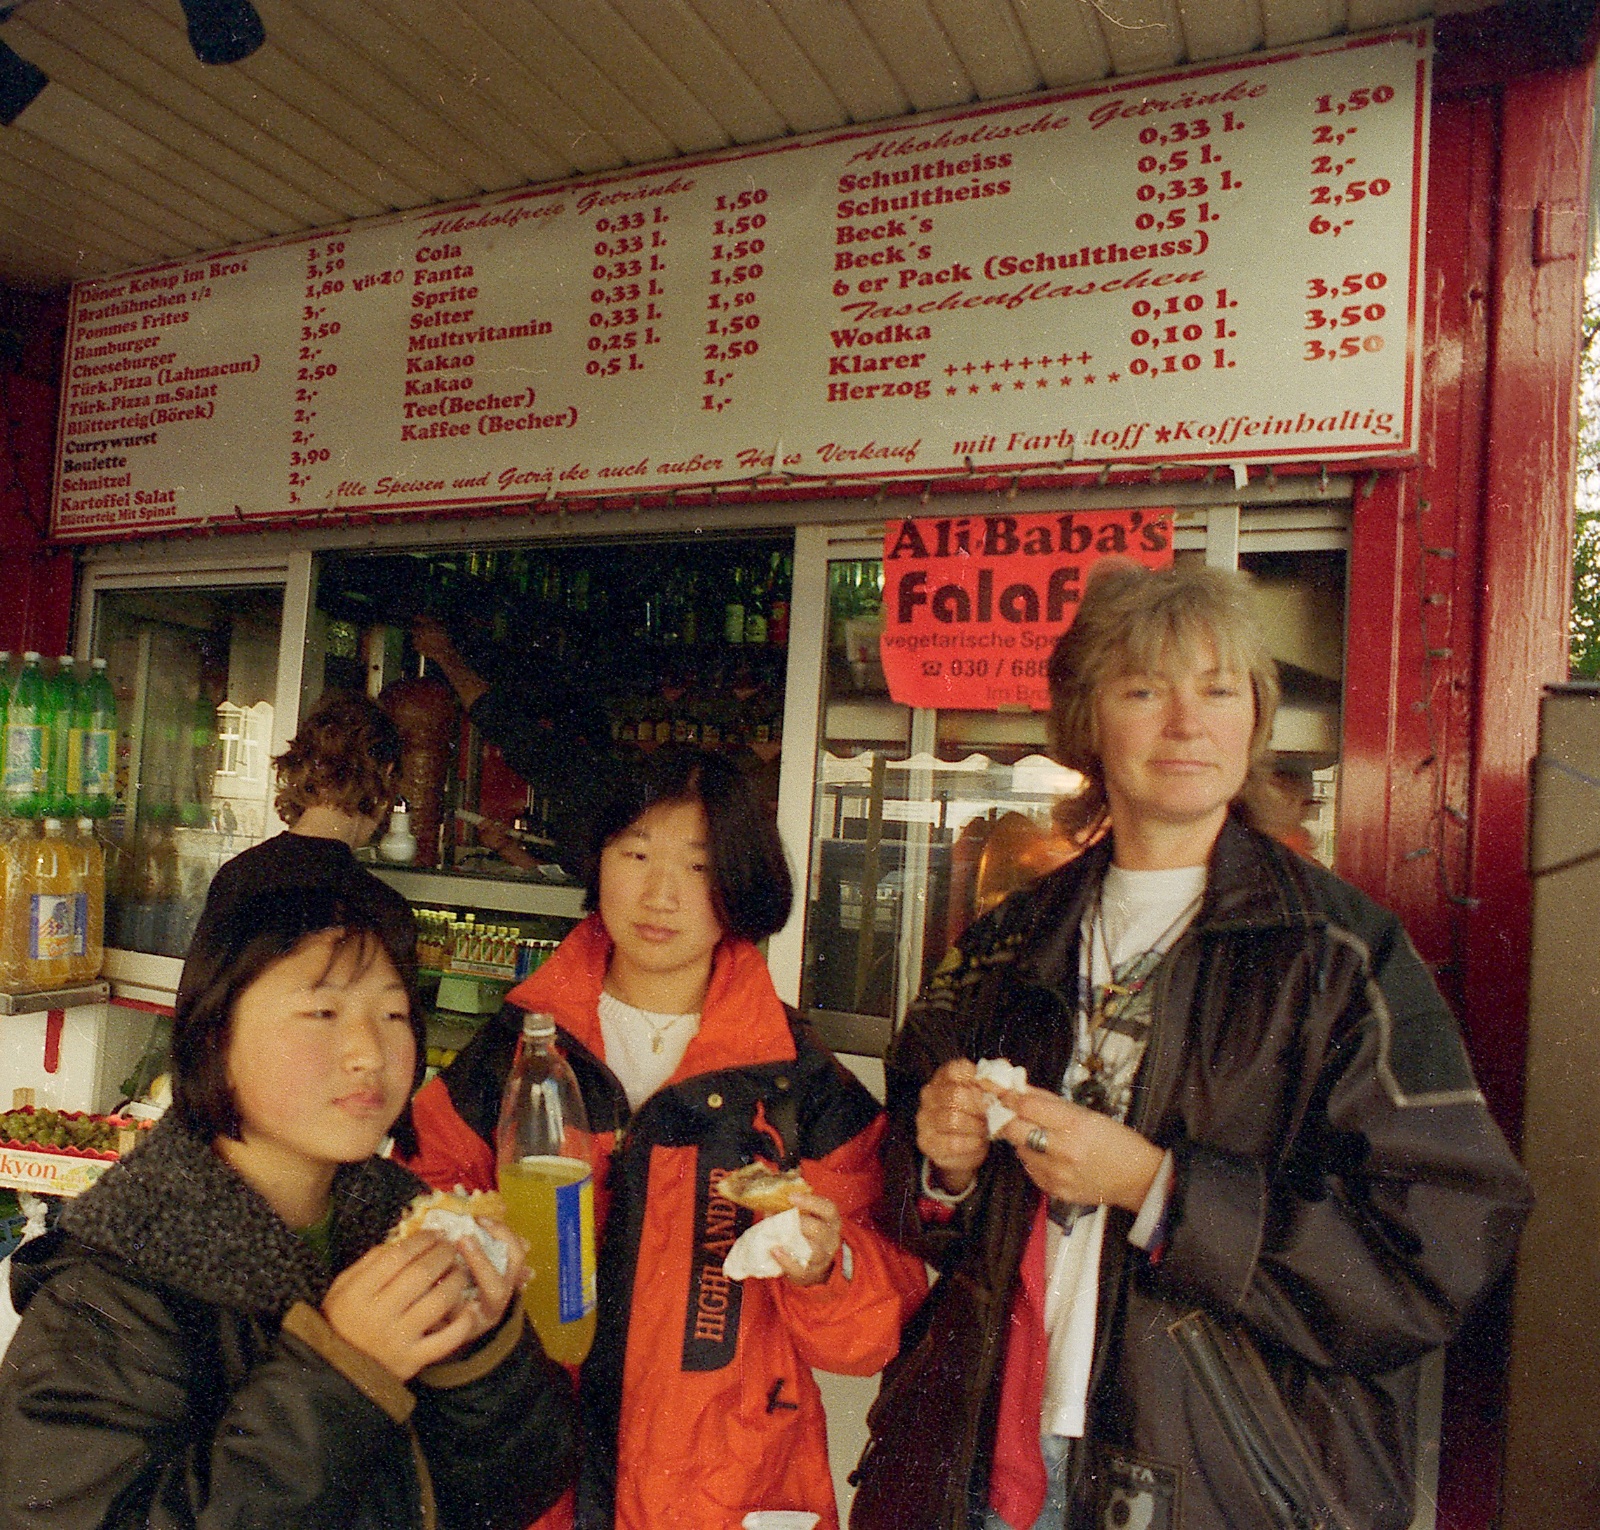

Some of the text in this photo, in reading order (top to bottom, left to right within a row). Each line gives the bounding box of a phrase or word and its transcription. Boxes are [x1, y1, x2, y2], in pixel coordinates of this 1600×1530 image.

[838, 152, 1012, 194] Schultheiss
[1138, 118, 1211, 146] 0,33
[1314, 84, 1395, 116] 1,50
[845, 79, 1269, 166] Alkoholische Getränke
[576, 177, 697, 215] Getränke
[837, 178, 1012, 220] Schultheiss
[1137, 150, 1188, 175] 0,5
[1312, 124, 1358, 145] 2,-
[1136, 176, 1208, 204] 0,33
[1310, 155, 1356, 176] 2,-
[415, 244, 462, 262] Cola
[596, 212, 645, 233] 0,33
[714, 189, 768, 212] 1,50
[1135, 208, 1186, 232] 0,5
[1310, 178, 1392, 206] 2,50
[411, 284, 478, 308] Sprite
[593, 259, 642, 281] 0,33
[711, 238, 765, 262] 1,50
[414, 264, 474, 285] Fanta
[594, 236, 643, 257] 0,33
[712, 214, 766, 237] 1,50
[898, 263, 973, 289] Pack
[984, 230, 1210, 280] (Schultheiss)
[1308, 214, 1354, 237] 6,-
[78, 292, 186, 323] Brathähnchen
[307, 259, 345, 279] 3,50
[80, 285, 125, 304] Döner
[129, 274, 178, 294] Kebap
[183, 269, 204, 284] im
[410, 308, 474, 330] Selter
[591, 283, 640, 305] 0,33
[709, 264, 763, 287] 1,50
[830, 323, 932, 348] Wodka
[1131, 294, 1204, 320] 0,10
[1306, 271, 1388, 300] 3,50
[841, 269, 1205, 321] Taschenflaschen
[74, 336, 160, 360] Hamburger
[76, 320, 137, 342] Pommes
[142, 312, 190, 329] Frites
[406, 354, 475, 375] Kakao
[587, 331, 637, 353] 0,25
[706, 314, 760, 336] 1,50
[408, 319, 553, 353] Multivitamin
[589, 308, 638, 329] 0,33
[707, 292, 755, 312] 1,50
[828, 353, 926, 376] Klarer
[1130, 324, 1203, 348] 0,10
[1304, 303, 1386, 330] 3,50
[71, 376, 151, 398] Türk.Pizza
[158, 354, 261, 386] (Lahmacun)
[72, 322, 340, 379] Cheeseburger 3,50
[405, 377, 473, 396] Kakao
[586, 358, 621, 378] 0,5
[704, 340, 759, 362] 2,50
[827, 380, 932, 402] Herzog
[1130, 354, 1202, 378] 0,10
[1303, 334, 1385, 362] 3,50
[69, 364, 337, 416] Türk.Pizza m.Salat 2,50
[66, 432, 157, 454] Currywurst
[401, 420, 471, 441] Kaffee
[478, 406, 578, 436] (Becher)
[953, 435, 996, 455] mit
[62, 448, 330, 493] Schnitzel 3,90
[374, 477, 445, 497] Speisen
[452, 472, 491, 489] und
[598, 458, 649, 478] auch
[656, 454, 722, 473] außer
[817, 439, 922, 463] Verkauf
[61, 493, 130, 512] Kartoffel
[134, 490, 175, 504] Salat
[139, 506, 176, 521] Spinat
[888, 511, 1169, 560] Ali Baba's
[884, 632, 1015, 651] vegetarische
[951, 659, 988, 677] 030
